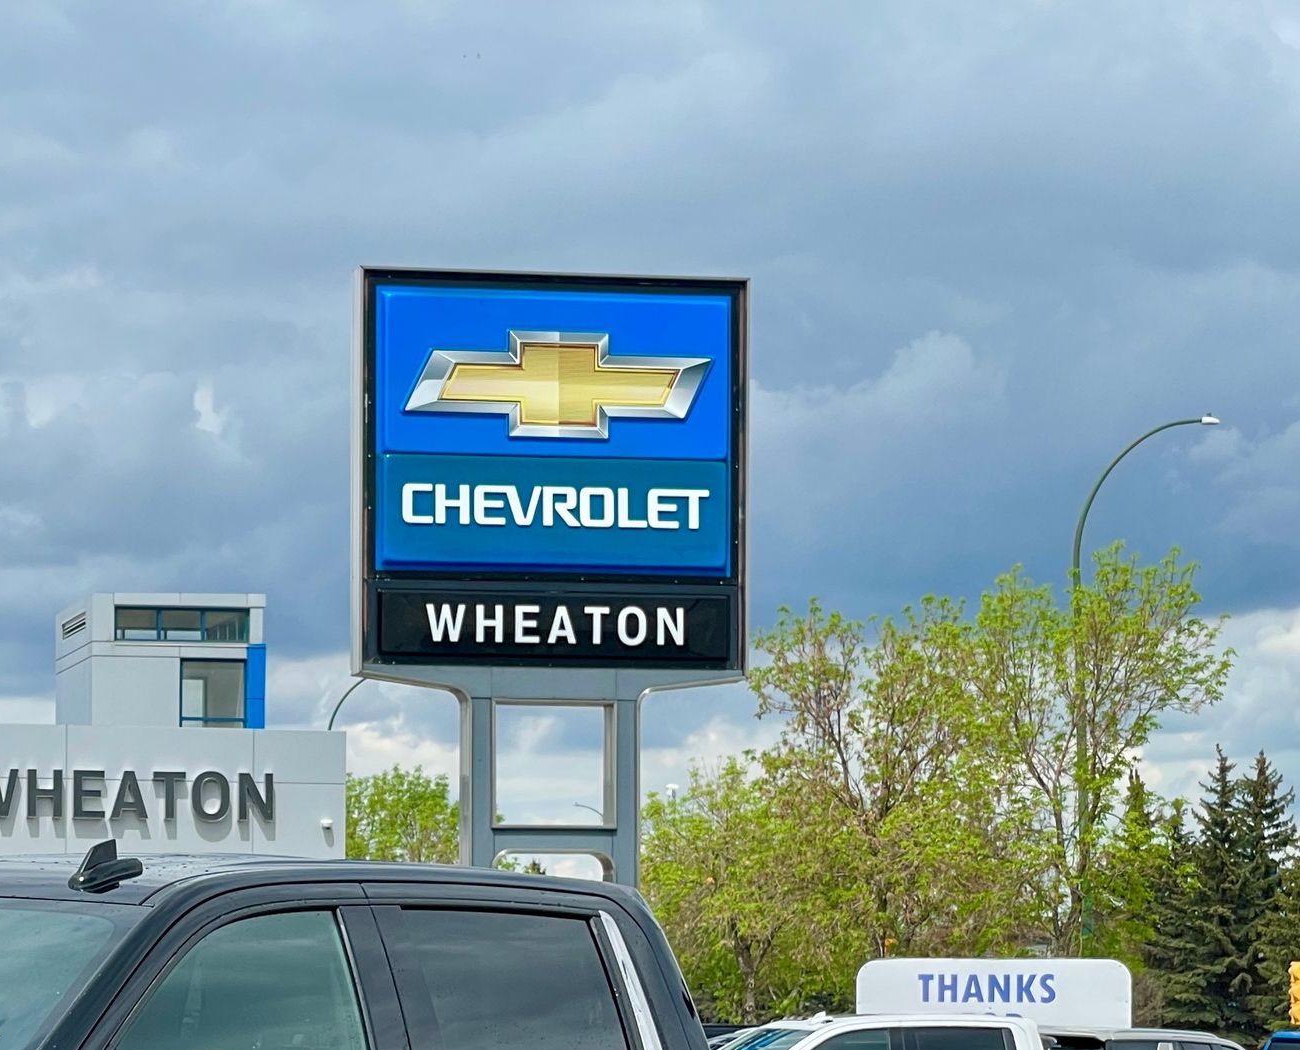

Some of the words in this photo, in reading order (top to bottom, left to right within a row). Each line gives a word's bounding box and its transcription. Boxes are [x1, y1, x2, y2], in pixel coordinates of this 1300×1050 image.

[402, 483, 710, 530] CHEVROLET
[425, 603, 685, 646] WHEATON
[918, 973, 1056, 1004] THANKS
